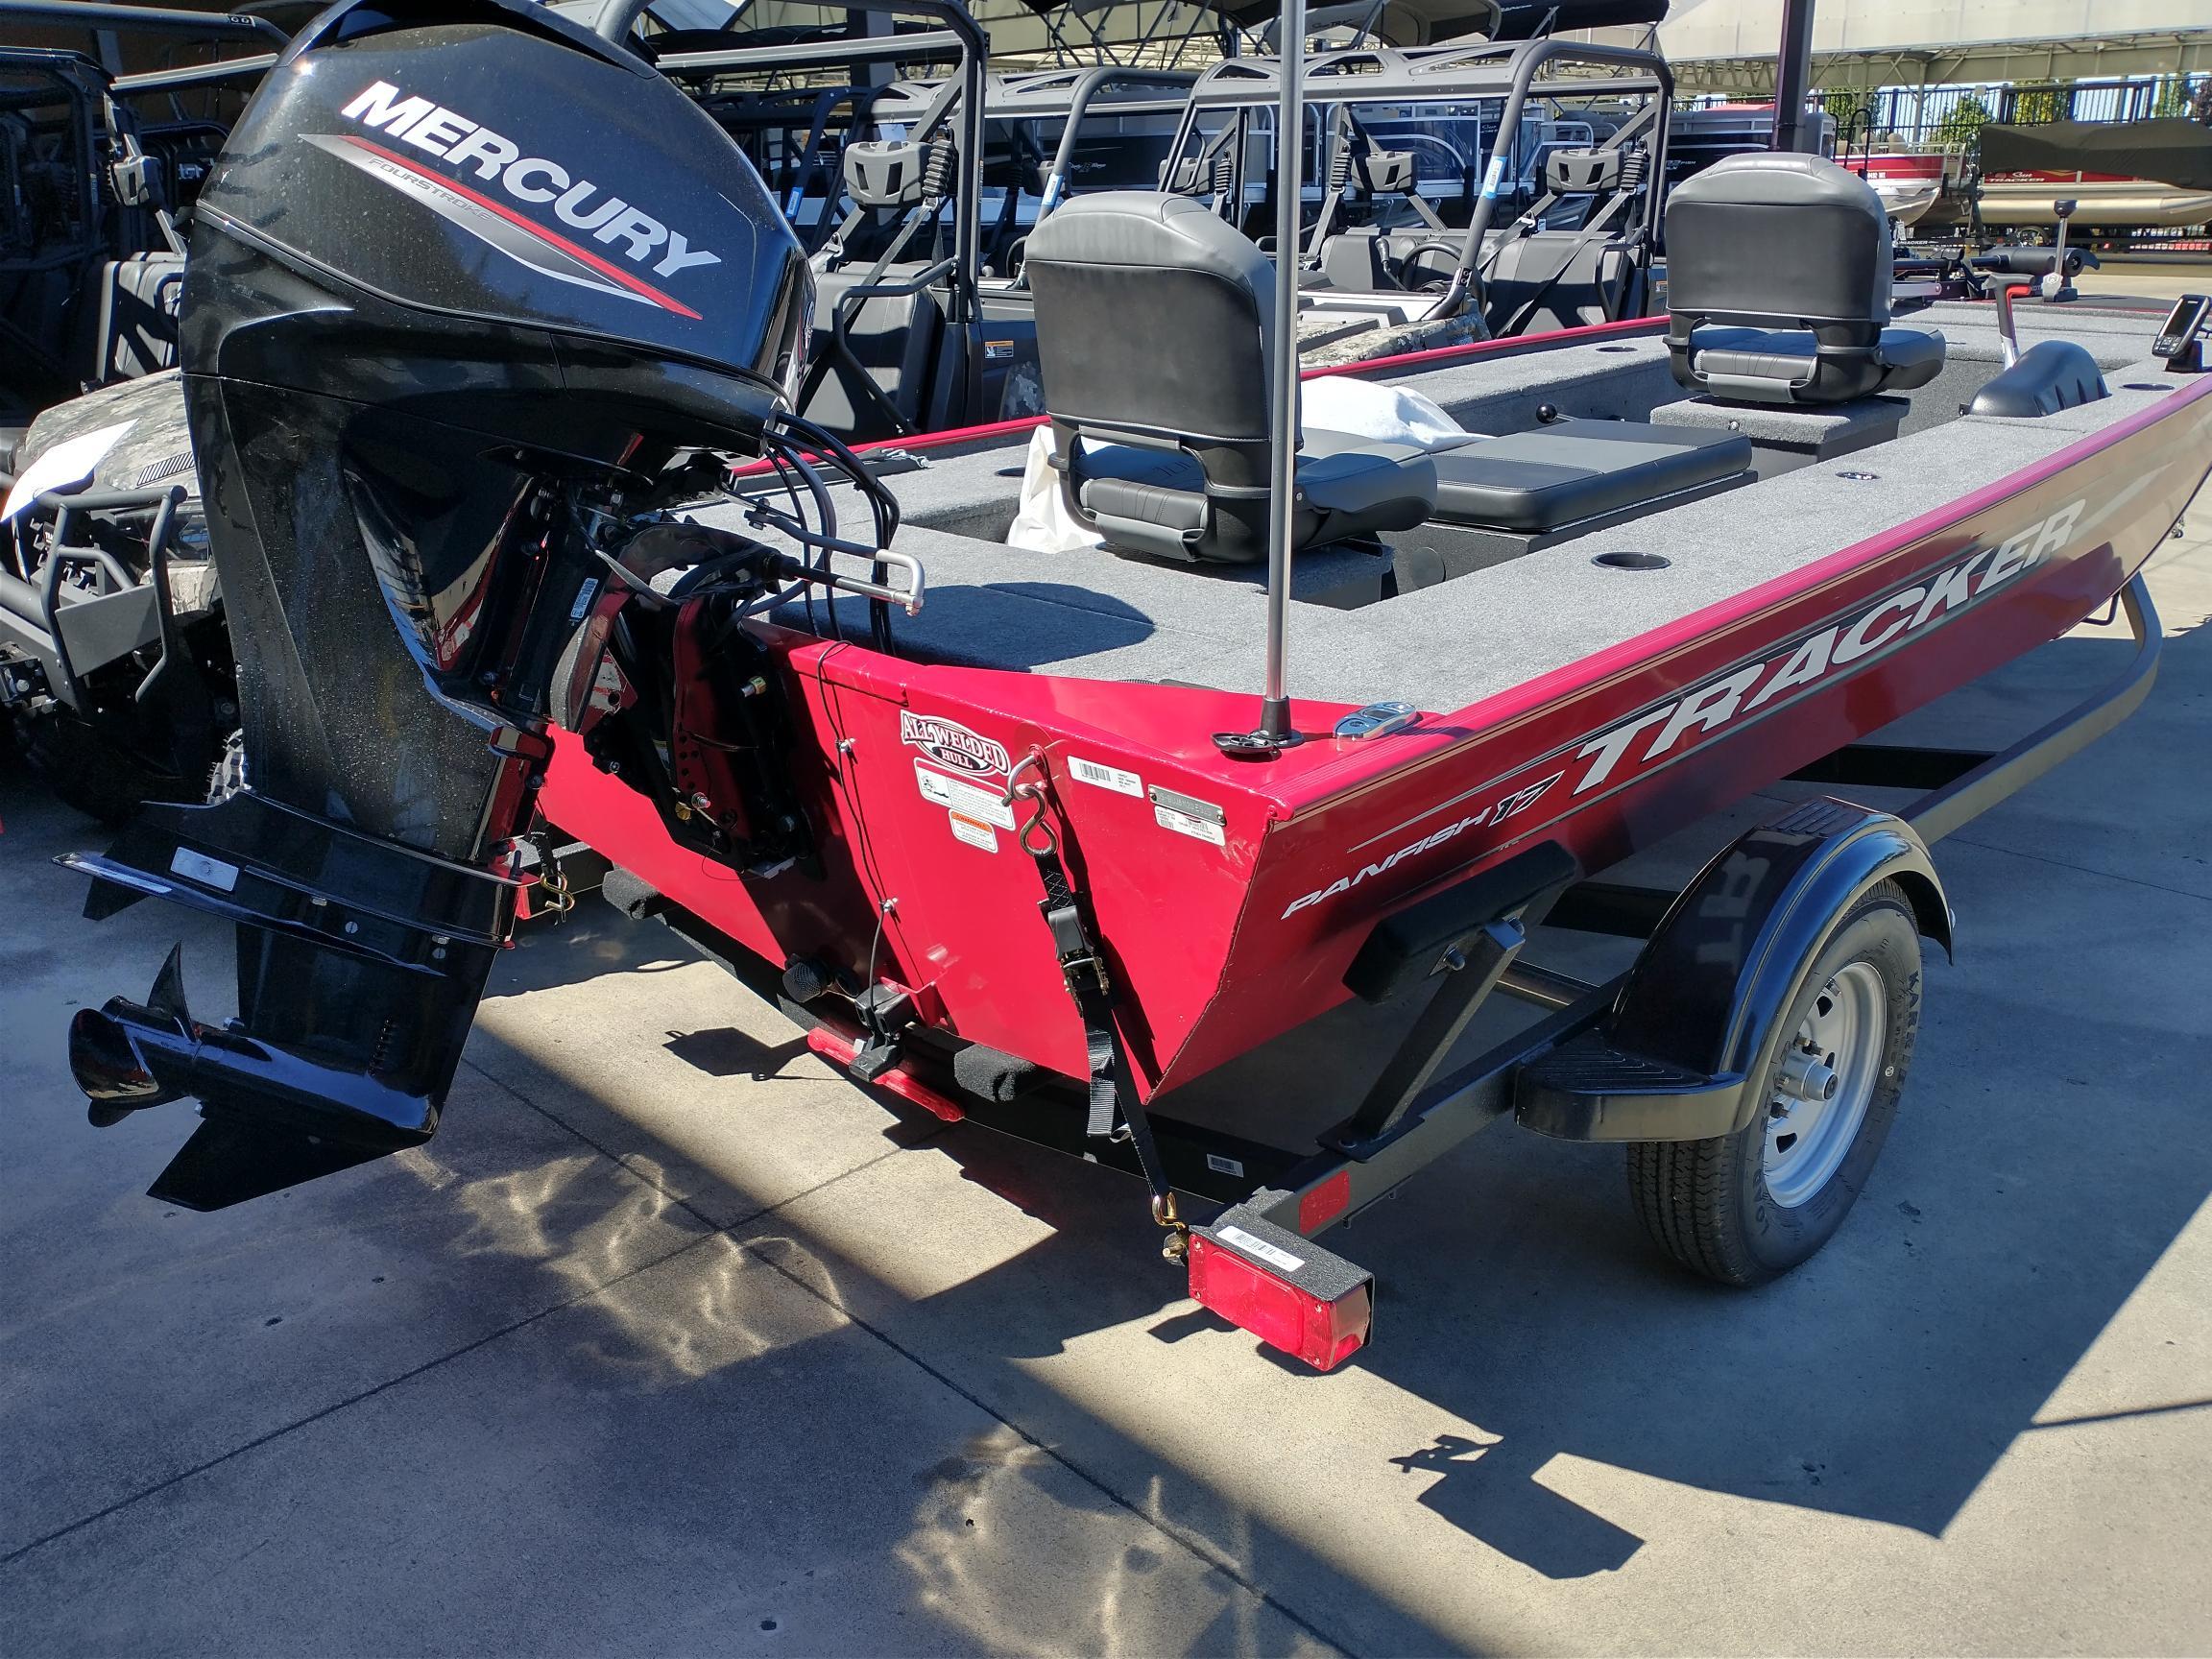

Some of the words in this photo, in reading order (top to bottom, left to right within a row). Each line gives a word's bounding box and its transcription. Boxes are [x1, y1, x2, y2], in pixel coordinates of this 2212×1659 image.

[341, 80, 722, 277] MERCURY
[368, 156, 493, 222] FOURSTROKE
[1573, 498, 2086, 796] TRACKER
[902, 711, 935, 743] ALL
[931, 723, 1009, 774] WELDED
[940, 748, 974, 769] HULL
[1280, 805, 1493, 921] PANFISH
[1487, 769, 1567, 828] 17
